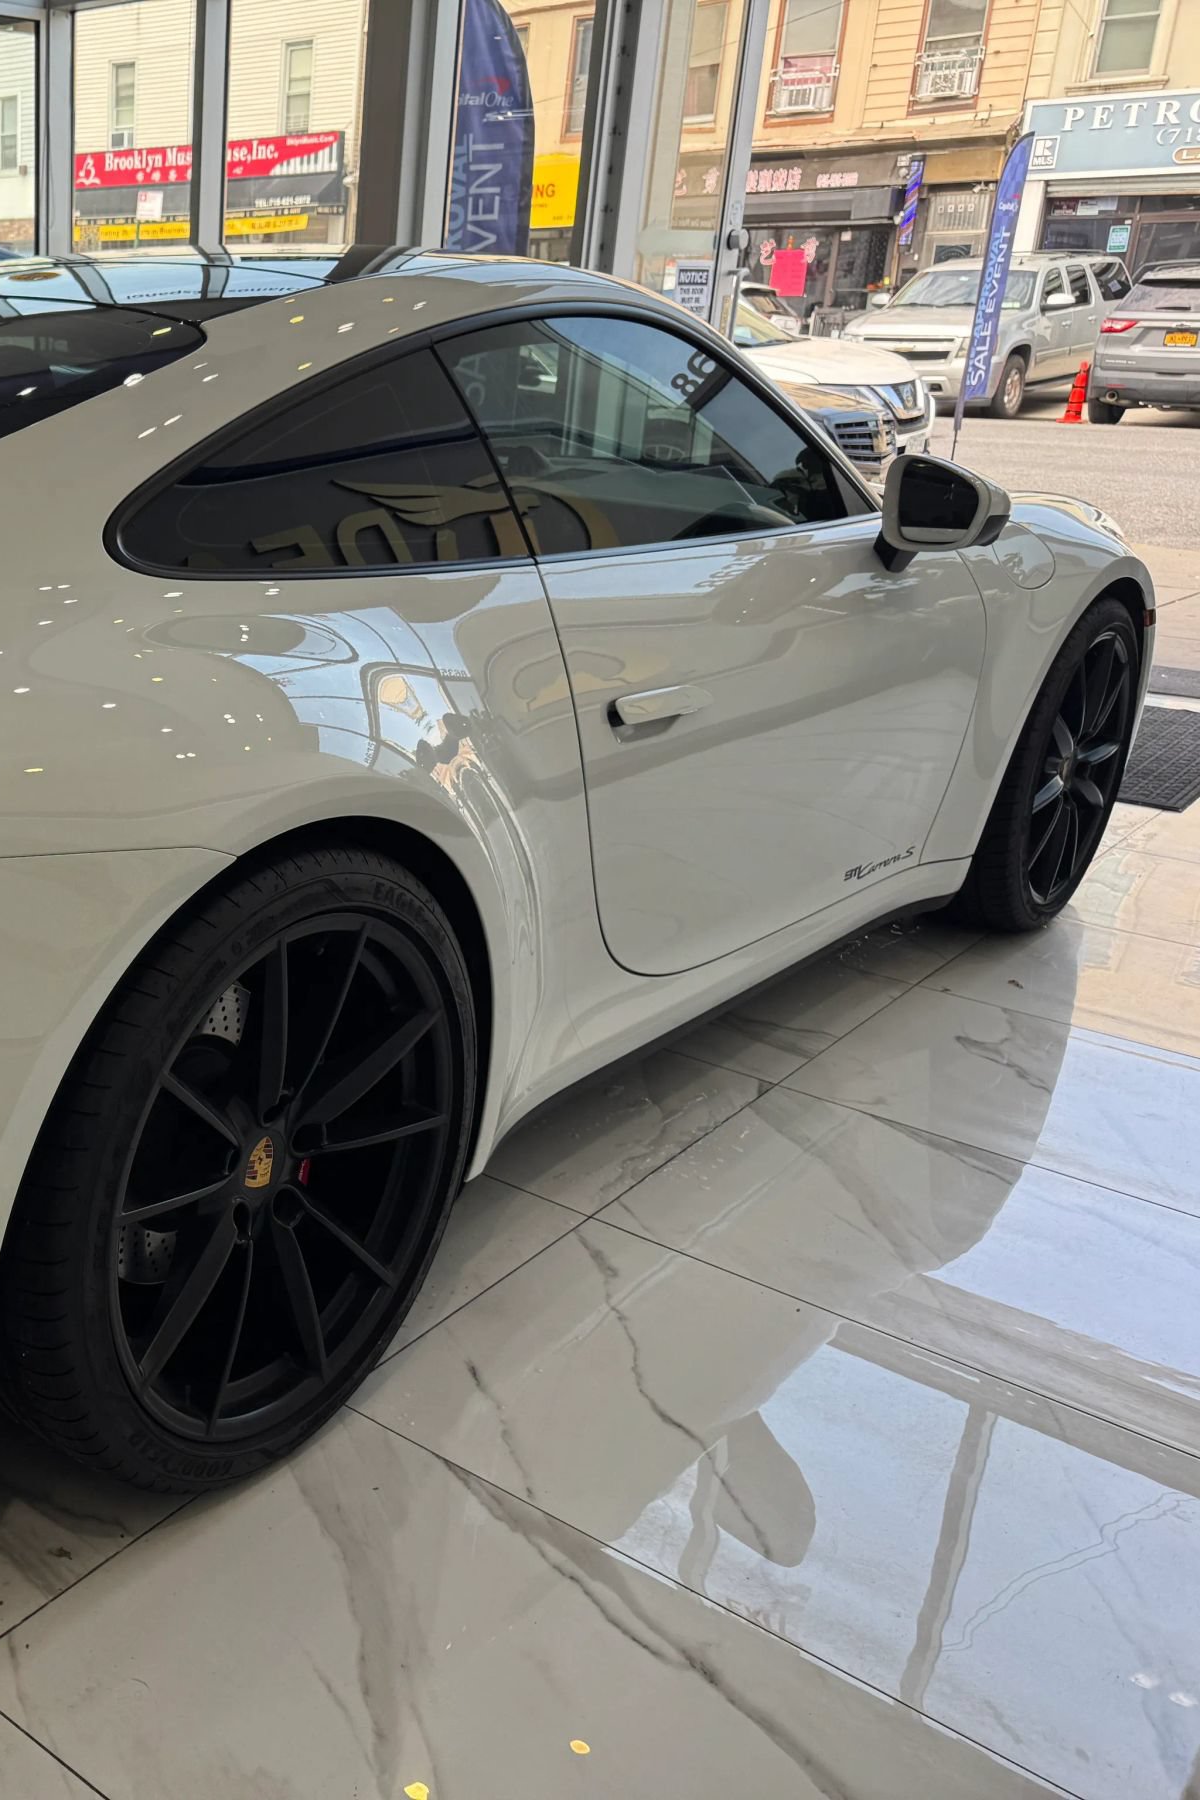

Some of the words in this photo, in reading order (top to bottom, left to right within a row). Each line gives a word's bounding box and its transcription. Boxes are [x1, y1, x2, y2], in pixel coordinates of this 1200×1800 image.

[104, 149, 163, 173] Brooklyn
[1032, 157, 1053, 166] MLS
[679, 271, 708, 284] NOTICE
[971, 321, 992, 386] SALE
[985, 226, 1011, 314] EVENT
[901, 846, 916, 860] S
